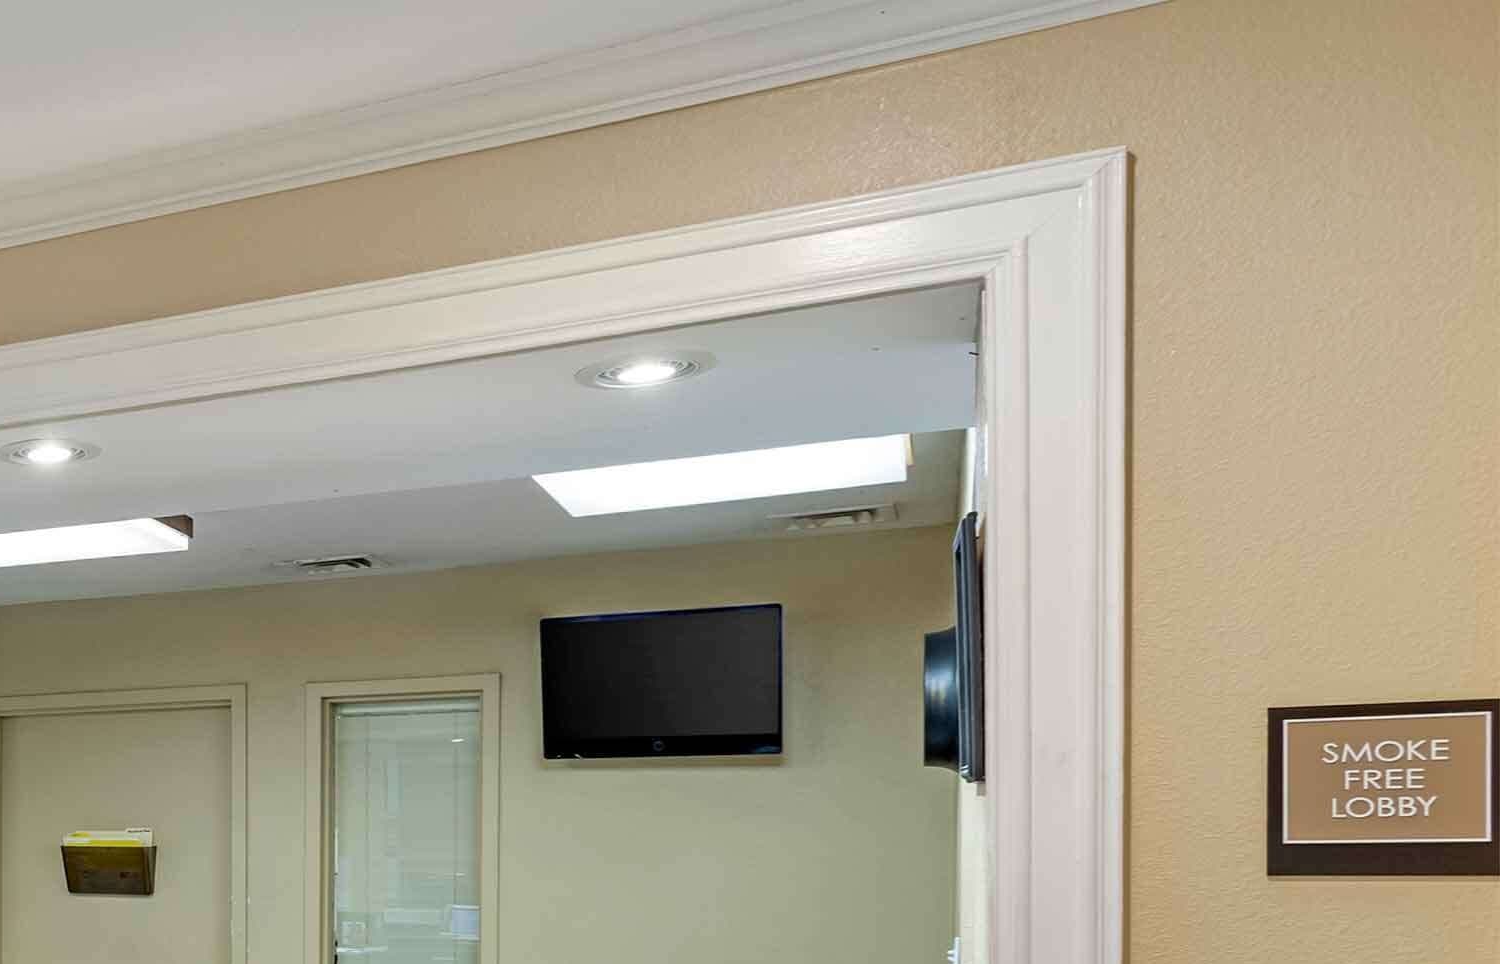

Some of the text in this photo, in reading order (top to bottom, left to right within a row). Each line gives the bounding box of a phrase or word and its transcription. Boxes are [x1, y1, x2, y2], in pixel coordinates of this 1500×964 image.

[1321, 738, 1450, 764] SMOKE
[1343, 768, 1426, 790] FREE
[1331, 795, 1438, 819] LOBBY
